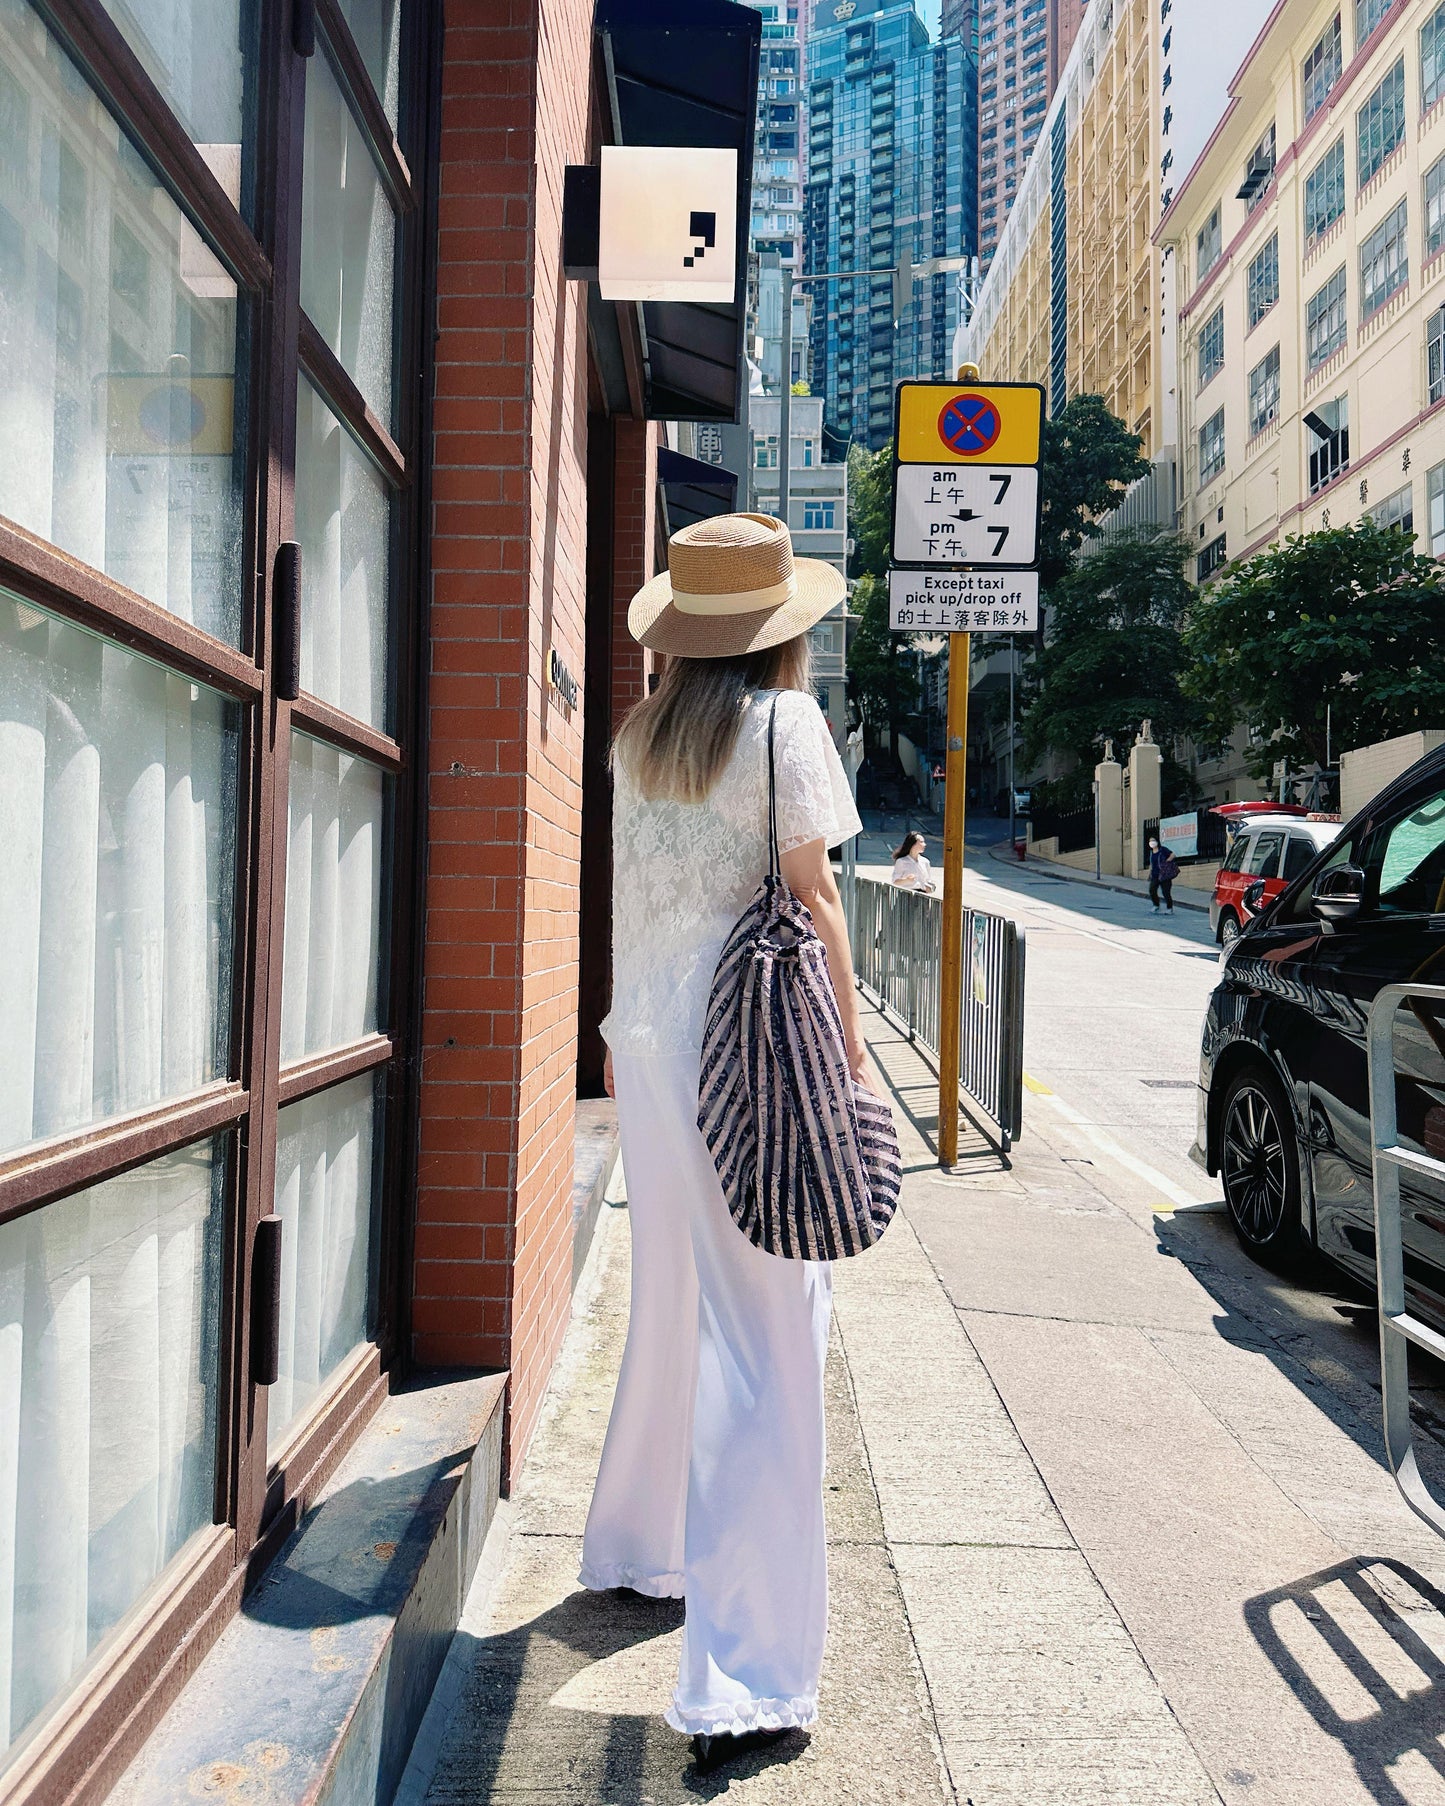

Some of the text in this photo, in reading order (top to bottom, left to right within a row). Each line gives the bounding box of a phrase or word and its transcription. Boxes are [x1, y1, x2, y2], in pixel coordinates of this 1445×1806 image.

[932, 470, 957, 482] am
[924, 487, 965, 505] 上午
[989, 474, 1012, 505] 7
[930, 522, 955, 537] pm
[922, 539, 963, 557] 下午
[987, 526, 1010, 557] 7
[924, 576, 1004, 592] Except taxi
[905, 592, 1022, 607] pick up/drop off
[897, 609, 1028, 626] 的士上落客除外
[1311, 813, 1341, 822] TAXI
